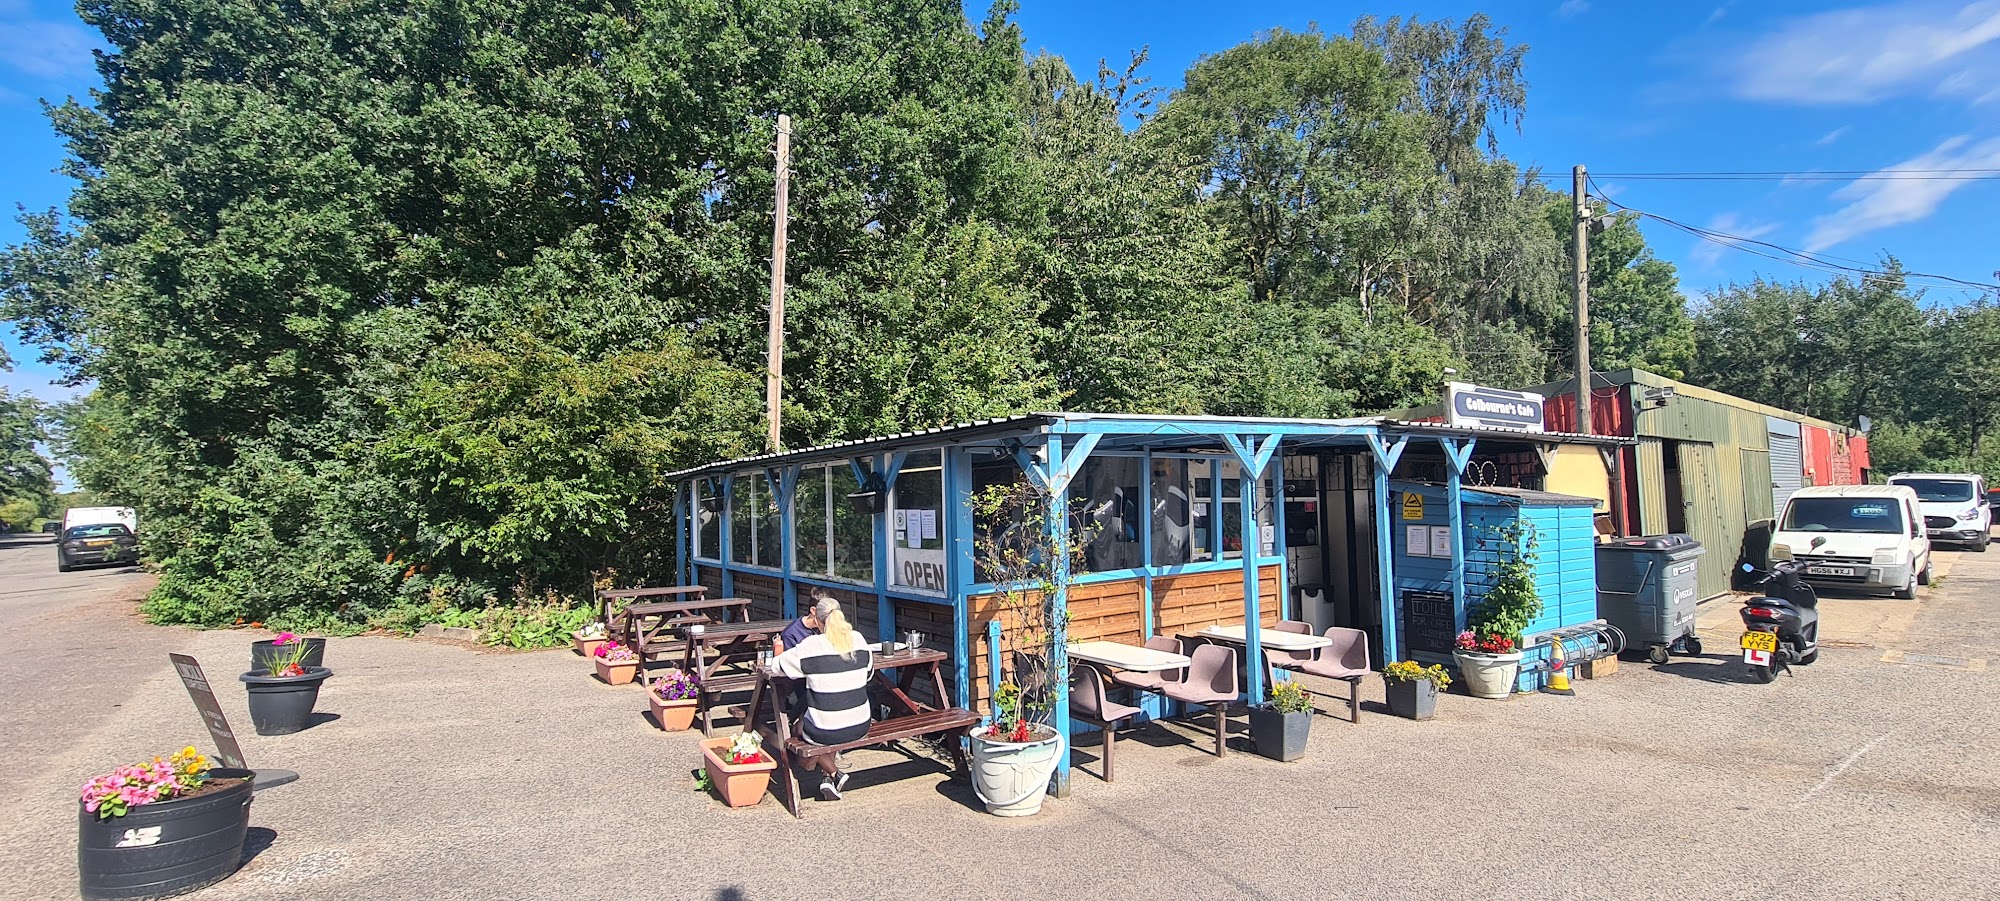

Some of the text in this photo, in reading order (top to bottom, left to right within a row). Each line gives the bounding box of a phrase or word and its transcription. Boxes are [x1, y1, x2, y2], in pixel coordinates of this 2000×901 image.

[1465, 396, 1534, 418] Colbourne's Cafe
[904, 560, 945, 590] OPEN
[1811, 567, 1832, 575] HG56
[1412, 616, 1452, 630] FOR CAFE
[1744, 631, 1774, 643] FP22
[1748, 640, 1770, 650] YYS
[1751, 650, 1764, 662] L
